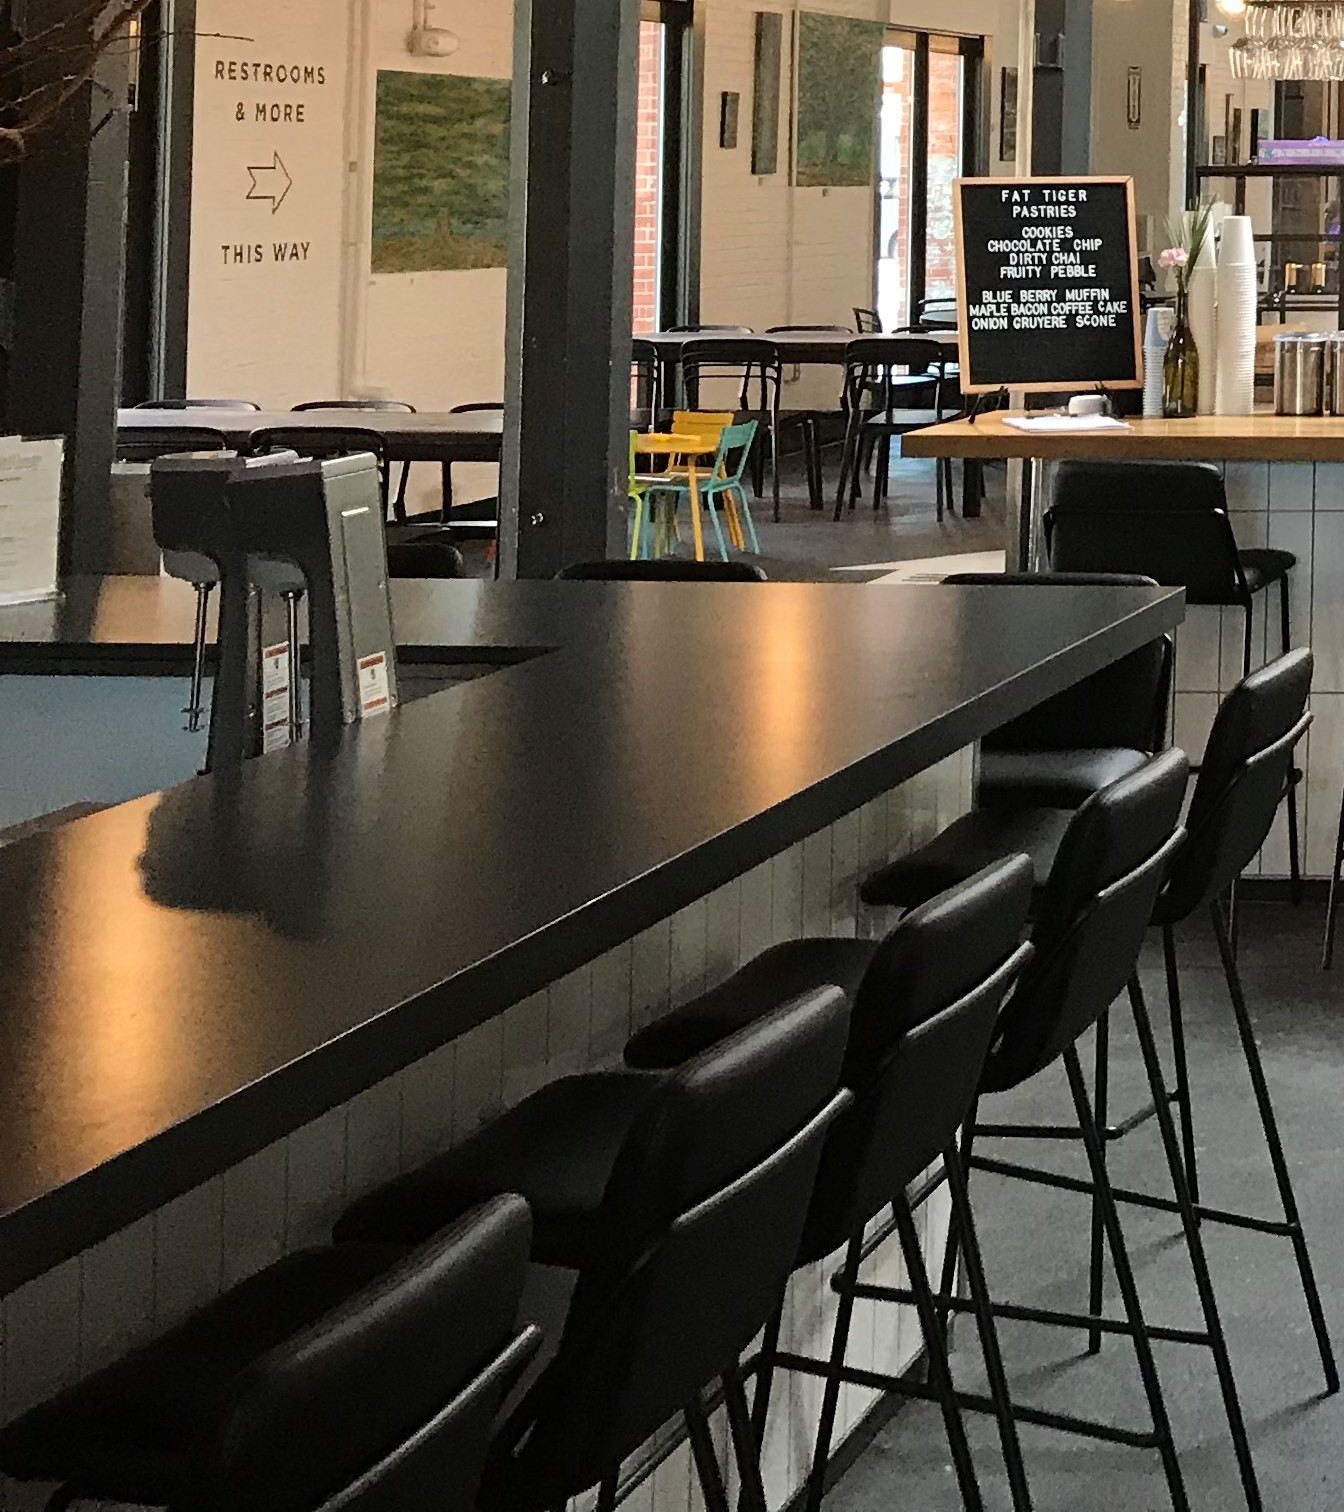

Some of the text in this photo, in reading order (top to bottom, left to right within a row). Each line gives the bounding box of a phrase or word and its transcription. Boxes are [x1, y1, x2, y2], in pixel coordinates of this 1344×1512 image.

[215, 60, 326, 85] RESTROOMS
[235, 102, 305, 122] & MORE
[1002, 190, 1087, 202] FAT TIGER
[1012, 205, 1076, 218] PASTRIES
[1022, 226, 1073, 238] COOKIES
[988, 239, 1102, 252] CHOCOLATE CHIP
[221, 241, 310, 264] THIS WAY
[1010, 252, 1080, 265] DIRTY CHAI
[1000, 265, 1096, 278] FRUITY PEBBLE
[982, 289, 1109, 303] BLUE BERRY MUFFIN
[969, 304, 1008, 316] MAPLE
[1011, 303, 1047, 315] BACON
[1051, 302, 1093, 314] COFFEE
[972, 317, 1008, 330] ONION
[1013, 316, 1067, 329] GRUYERE
